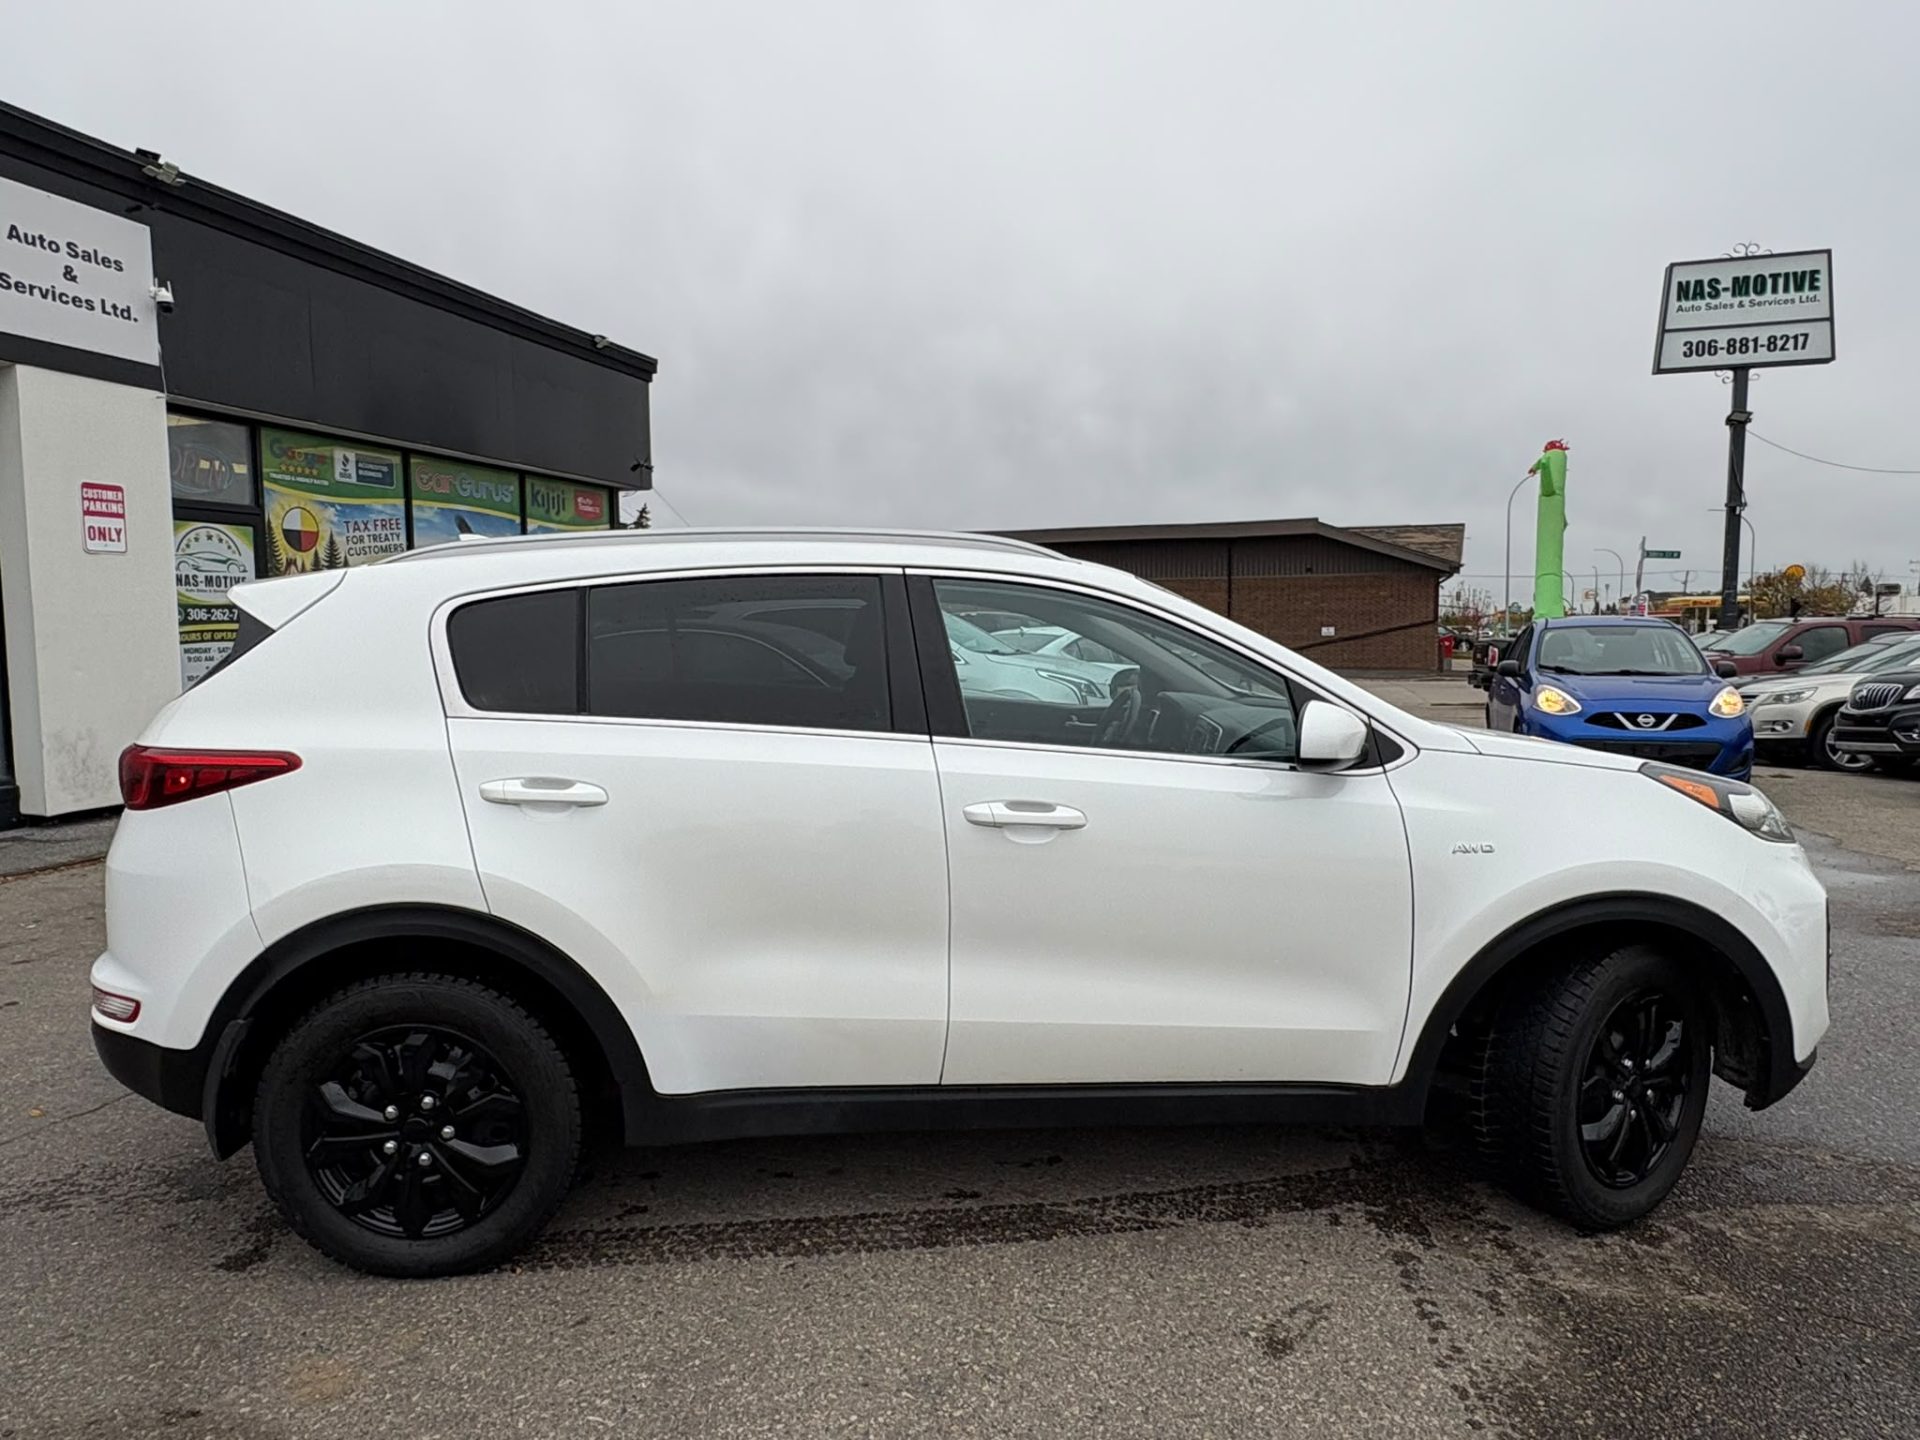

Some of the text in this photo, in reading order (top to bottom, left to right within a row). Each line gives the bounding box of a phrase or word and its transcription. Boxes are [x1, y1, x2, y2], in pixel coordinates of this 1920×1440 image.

[6, 223, 125, 273] Auto Sales
[62, 264, 79, 285] &
[1676, 269, 1822, 302] NAS-MOTIVE
[0, 272, 139, 323] Services Ltd.
[1675, 294, 1821, 314] Auto Sales & Services Ltd.
[1682, 332, 1810, 358] 306-881-8217
[83, 499, 124, 515] PARKING
[87, 525, 123, 543] ONLY
[343, 517, 402, 534] TAX FREE
[345, 532, 401, 546] FOR TREATY
[347, 543, 405, 557] CUSTOMERS
[187, 608, 239, 621] 306-262-7
[180, 633, 201, 641] OURS
[183, 646, 232, 655] MONDAY SAT
[1451, 843, 1496, 854] AWD
